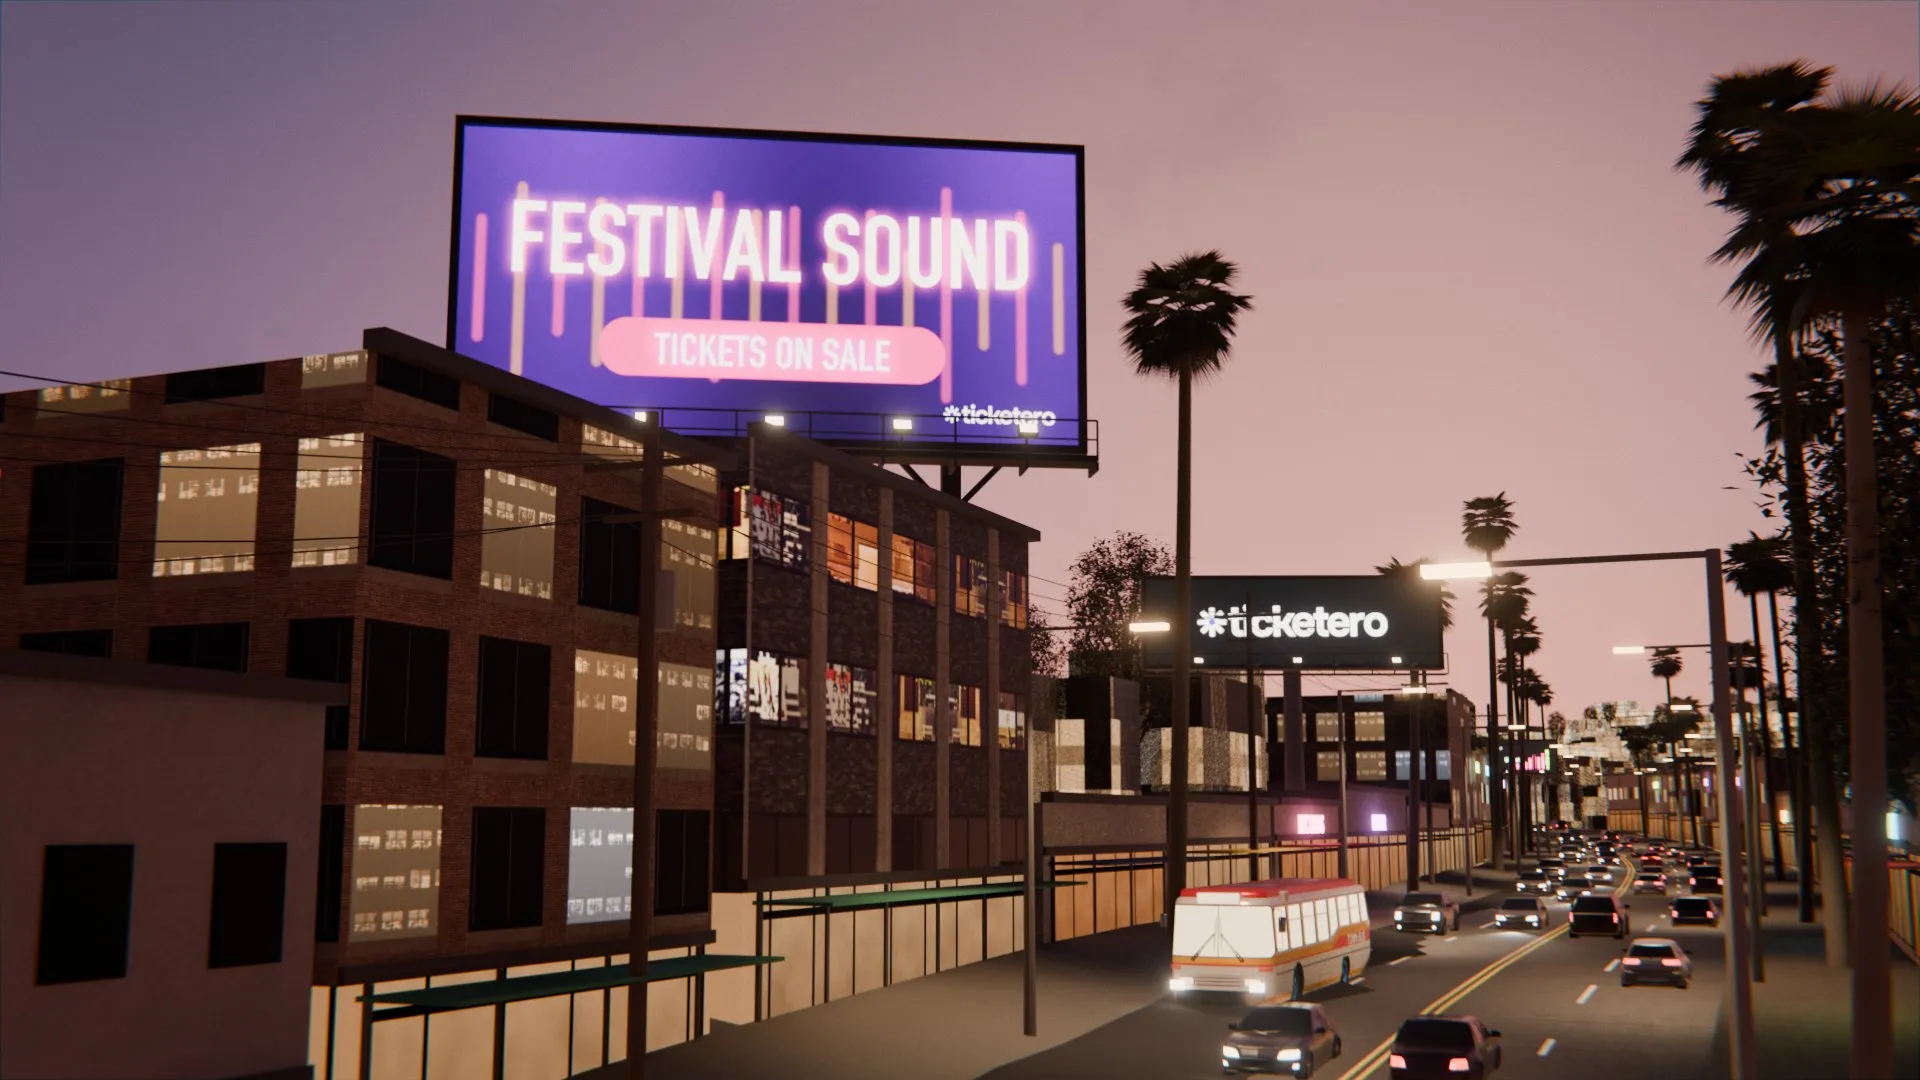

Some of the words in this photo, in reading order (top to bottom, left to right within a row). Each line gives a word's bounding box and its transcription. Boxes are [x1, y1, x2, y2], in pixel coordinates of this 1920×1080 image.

[510, 199, 802, 283] FESTIVAL
[822, 212, 1030, 291] SOUND
[654, 332, 768, 369] TICKETS
[775, 336, 813, 370] ON
[822, 338, 891, 373] SALE
[961, 403, 1056, 427] ticketero
